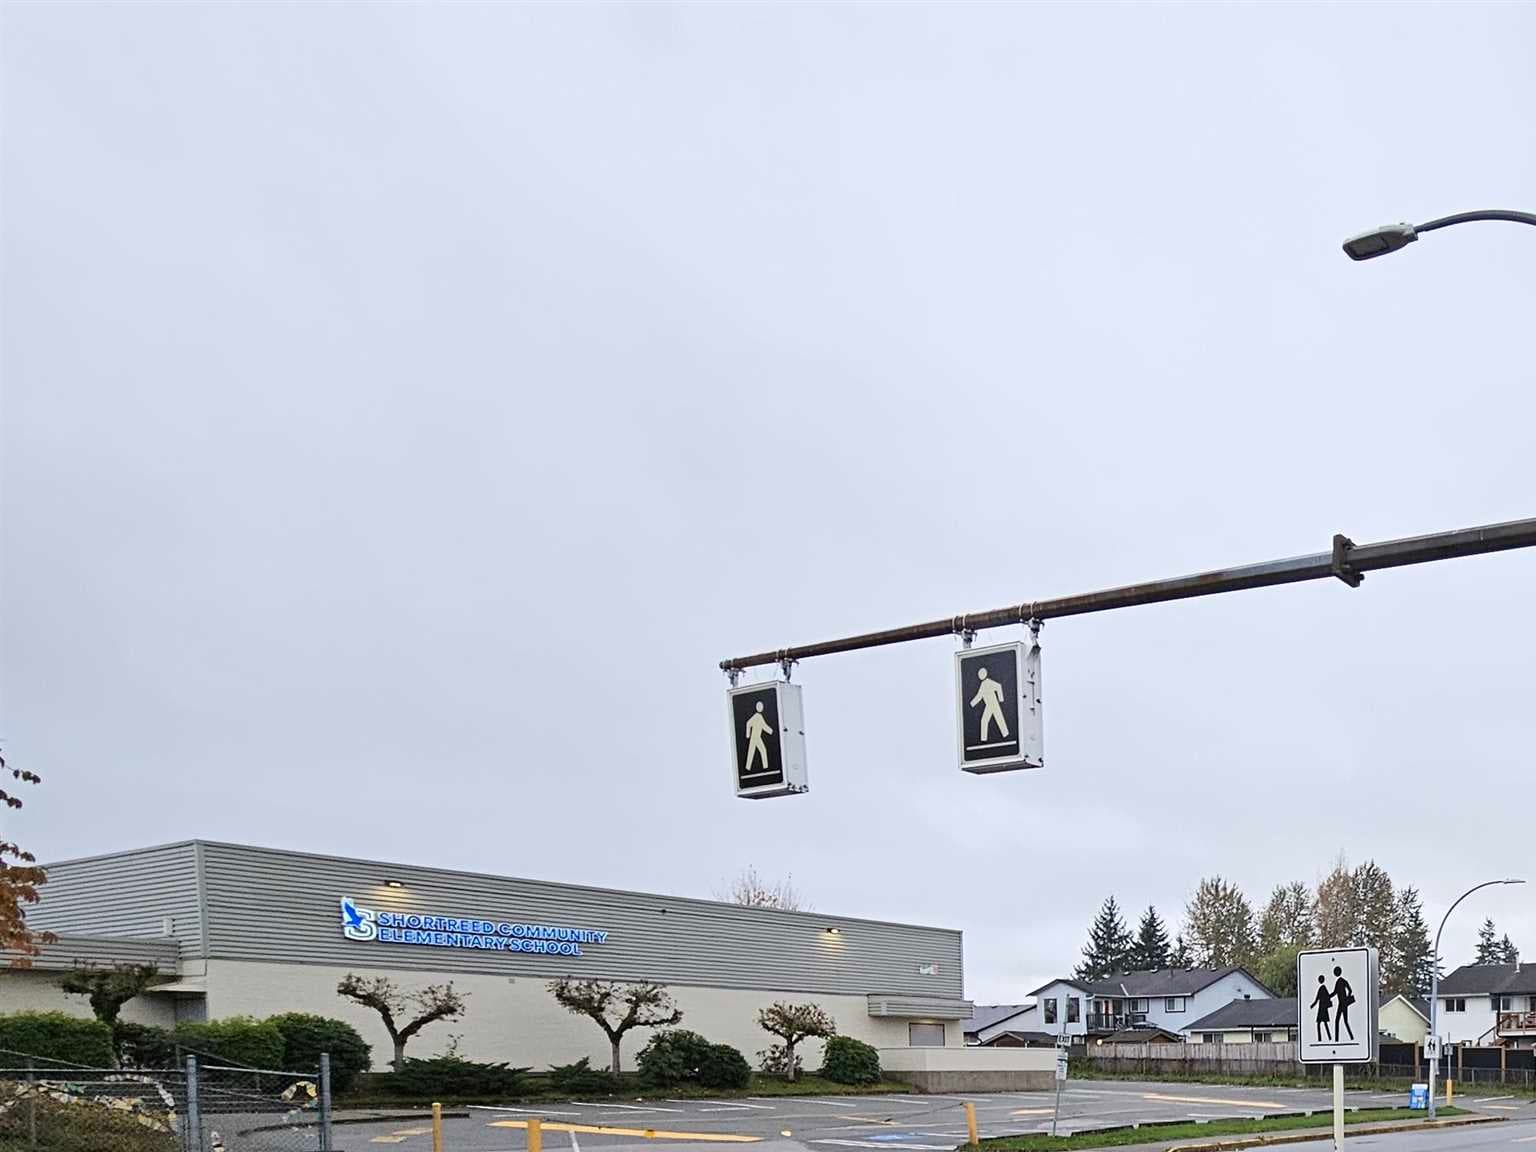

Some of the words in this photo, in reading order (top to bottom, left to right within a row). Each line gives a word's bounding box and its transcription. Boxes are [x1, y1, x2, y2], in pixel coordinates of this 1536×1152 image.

[378, 911, 496, 935] SHORTREED
[498, 922, 608, 943] COMMUNITY
[378, 927, 505, 950] ELEMENTARY
[510, 938, 583, 956] SCHOOL
